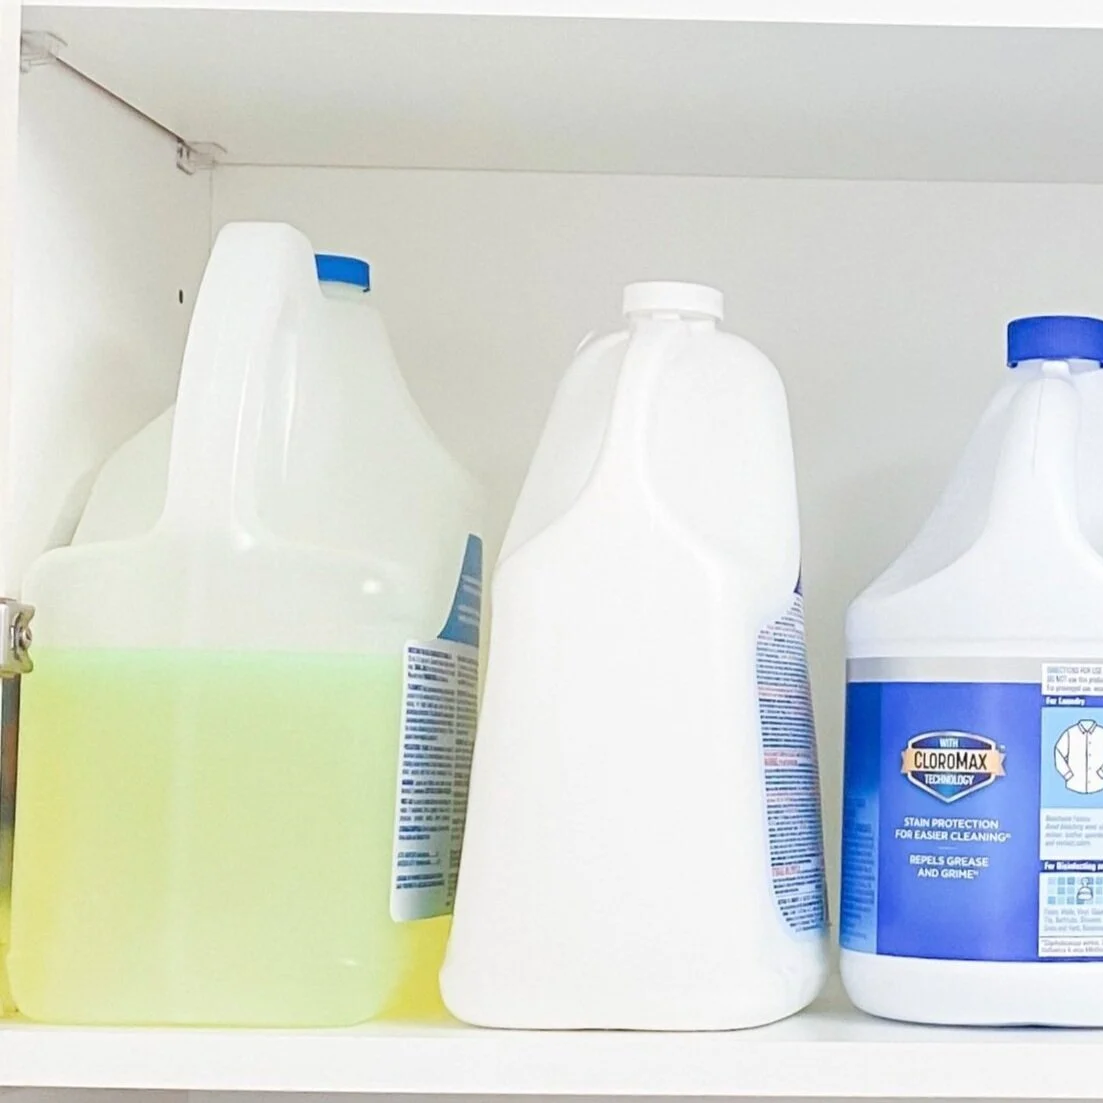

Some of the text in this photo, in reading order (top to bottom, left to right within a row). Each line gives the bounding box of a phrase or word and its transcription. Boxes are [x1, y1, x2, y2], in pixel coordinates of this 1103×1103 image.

[939, 738, 959, 748] WITH
[914, 751, 988, 770] CLOROMAX
[924, 773, 975, 786] TECHNOLOGY
[903, 817, 999, 829] STAIN PROTECTION
[895, 829, 913, 839] FOR
[914, 830, 949, 841] EASIER
[909, 855, 989, 867] REPELS GREASE
[917, 868, 939, 878] AND
